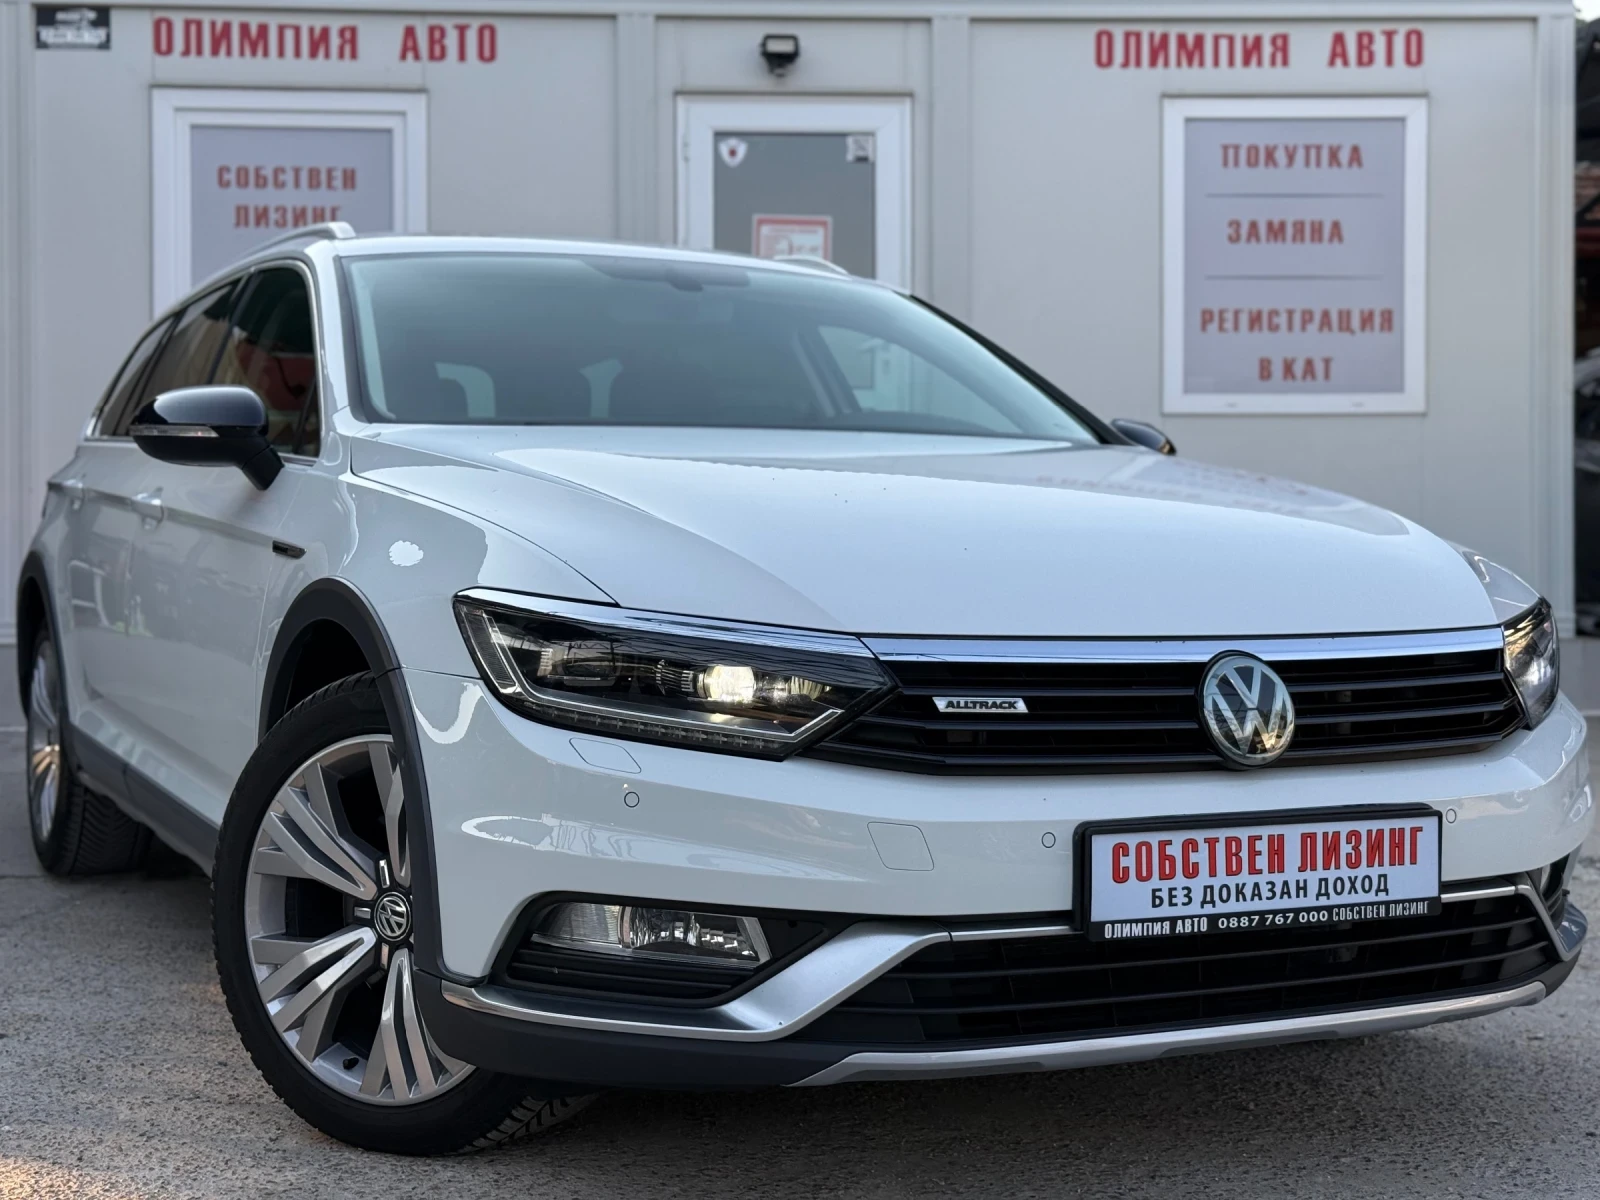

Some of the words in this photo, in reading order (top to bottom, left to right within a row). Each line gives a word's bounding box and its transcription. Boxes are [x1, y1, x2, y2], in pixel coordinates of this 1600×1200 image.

[153, 17, 358, 61] ОЛИМПИЯ
[399, 23, 497, 63] АВТО
[1095, 29, 1290, 69] ОЛИМПИЯ
[1327, 29, 1424, 68] АВТО
[1221, 144, 1364, 169] ПОКУПКА
[217, 164, 356, 191] СОБСТВЕН
[234, 204, 341, 229] ЛИЗИНГ
[1227, 220, 1344, 244] ЗАМЯНА
[1201, 308, 1394, 336] РЕГИСТРАЦИЯ
[1259, 357, 1271, 382] В
[1283, 357, 1334, 382] КАТ
[945, 700, 1017, 710] ALLTRACK
[1112, 833, 1285, 884] СОБСТВЕН
[1298, 826, 1423, 872] ЛИЗИНГ
[1151, 886, 1193, 909] БЕЗ
[1200, 879, 1308, 909] ДОКАЗАН
[1316, 873, 1389, 901] ДОХОД
[1104, 920, 1170, 939] ОЛИМПИЯ
[1175, 916, 1208, 934] АВТО
[1218, 915, 1259, 929] 0887
[1265, 912, 1295, 926] 767
[1298, 910, 1329, 923] 000
[1332, 904, 1386, 921] СОБСТВЕН
[1389, 900, 1430, 917] ЛИЗИНГ
